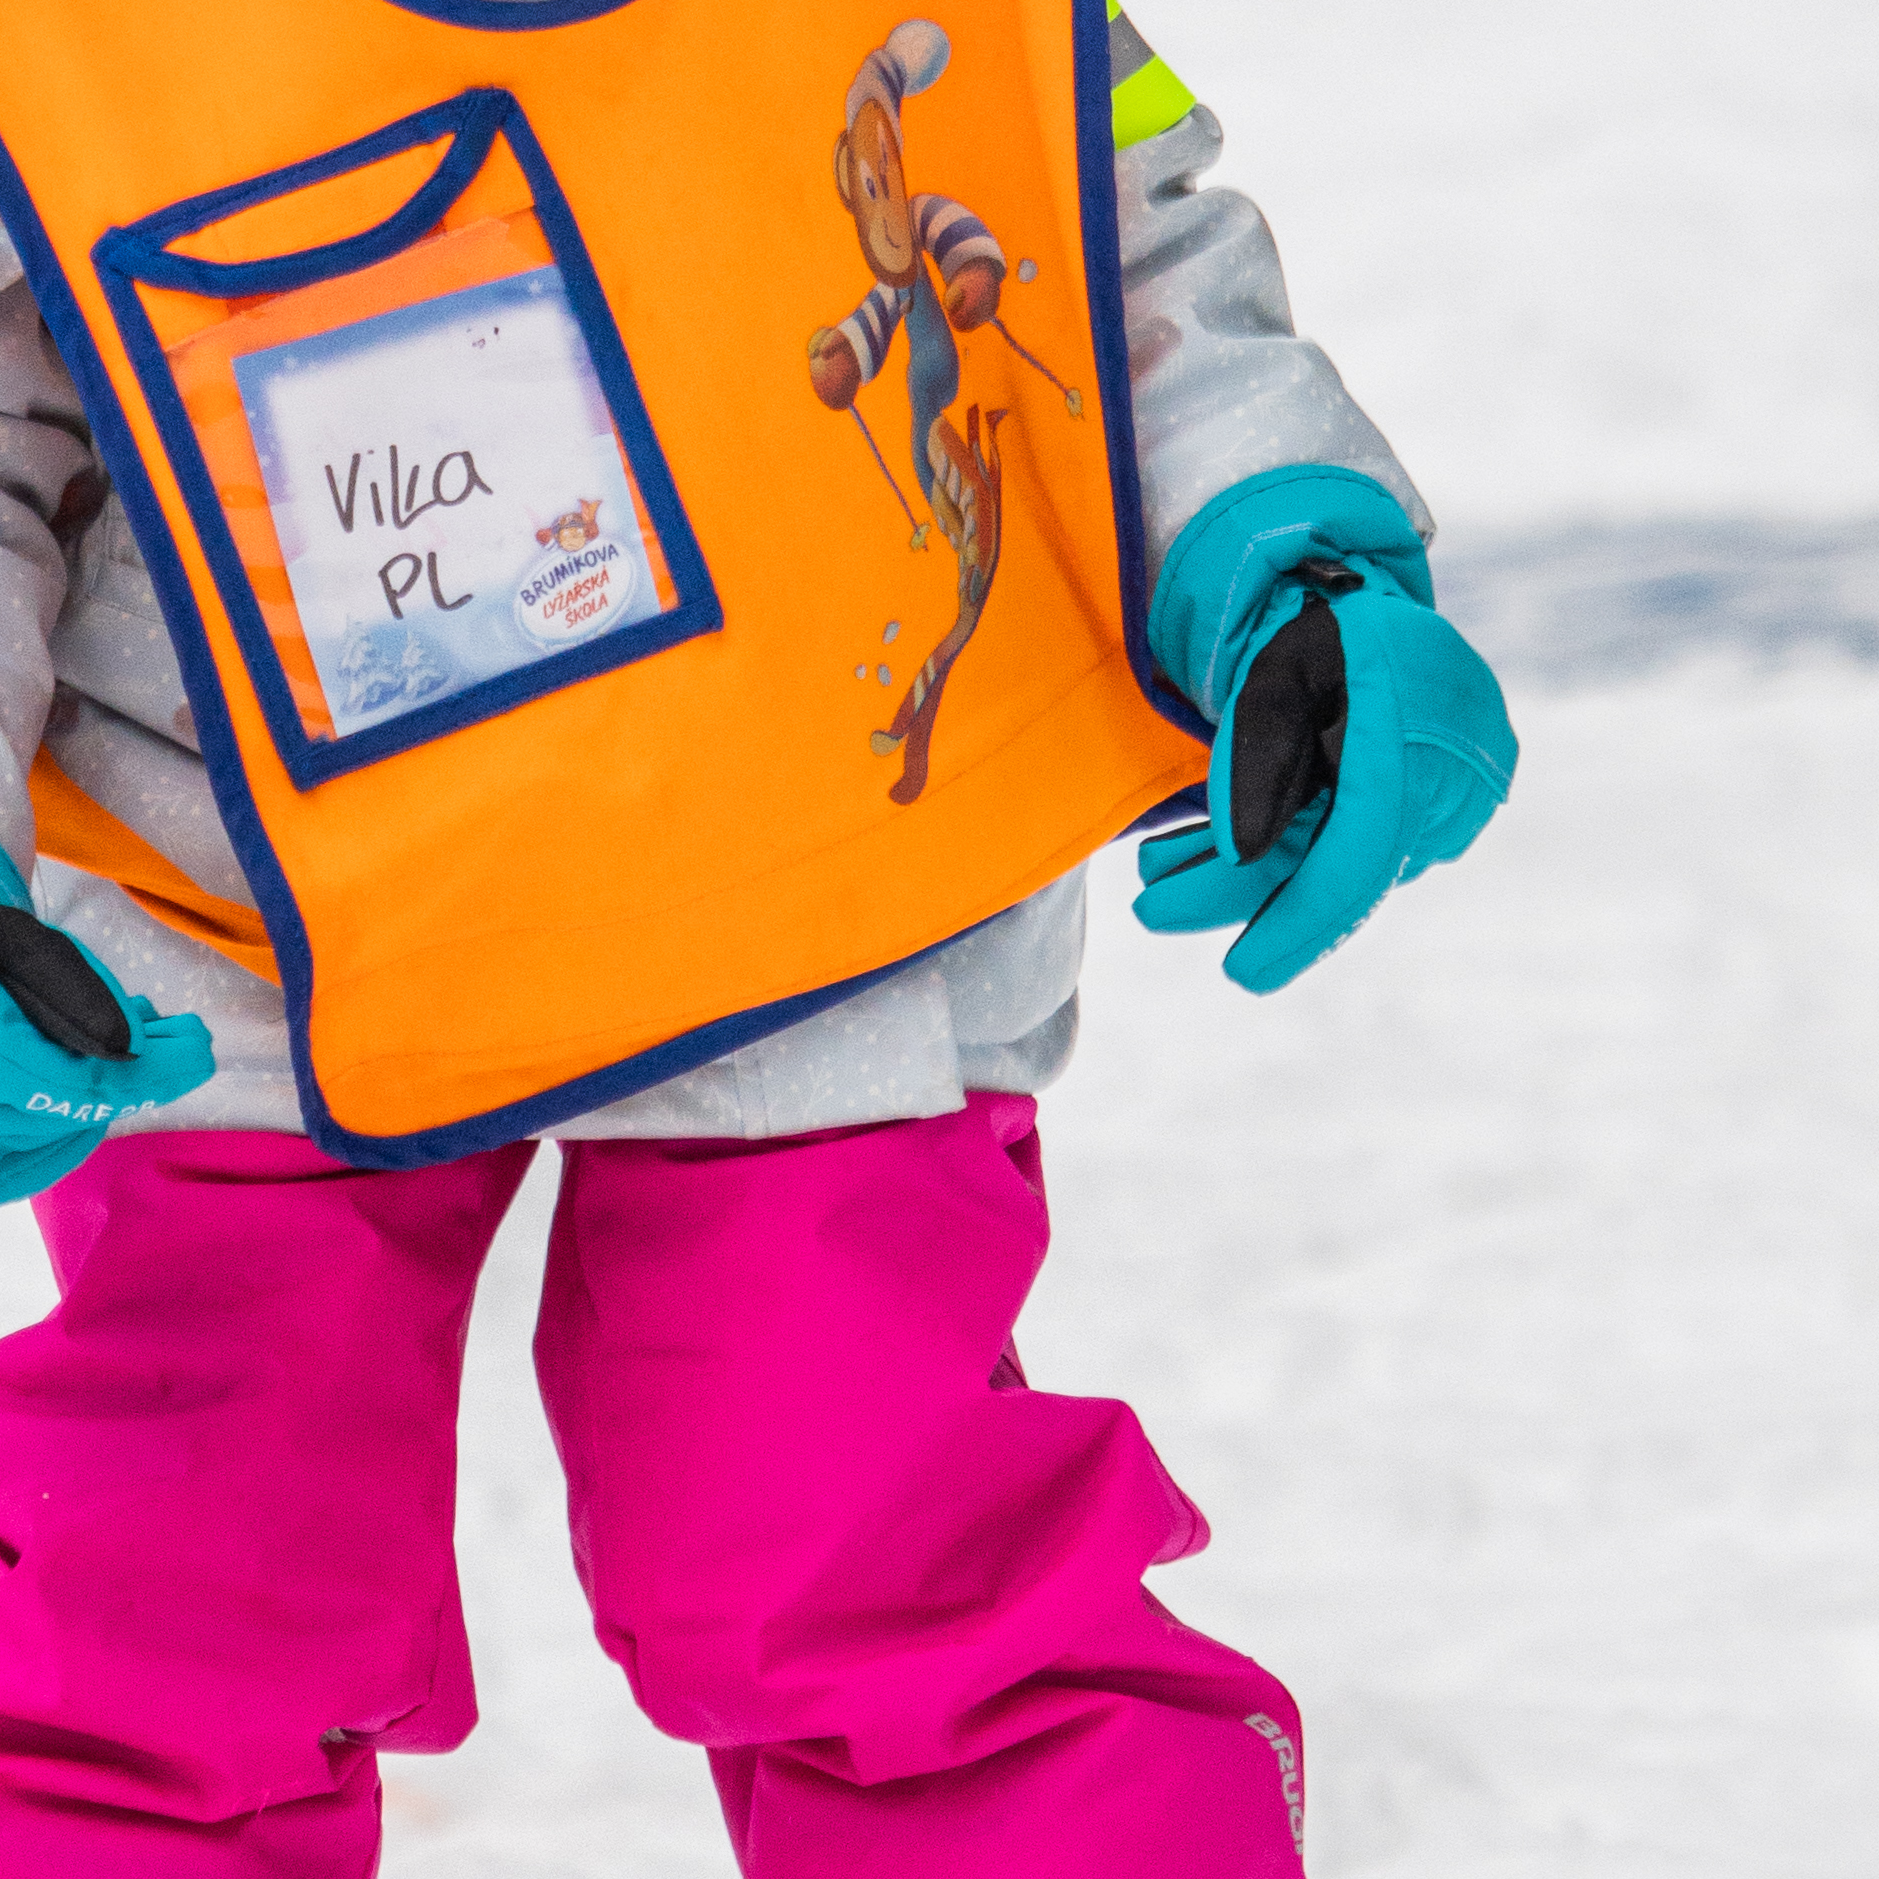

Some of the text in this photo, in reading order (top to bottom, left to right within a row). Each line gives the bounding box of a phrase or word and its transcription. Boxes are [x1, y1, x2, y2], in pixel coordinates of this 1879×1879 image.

[377, 551, 474, 620] PL
[520, 543, 620, 607] BRUMÍKOVA
[564, 592, 609, 629] ŠKOLA
